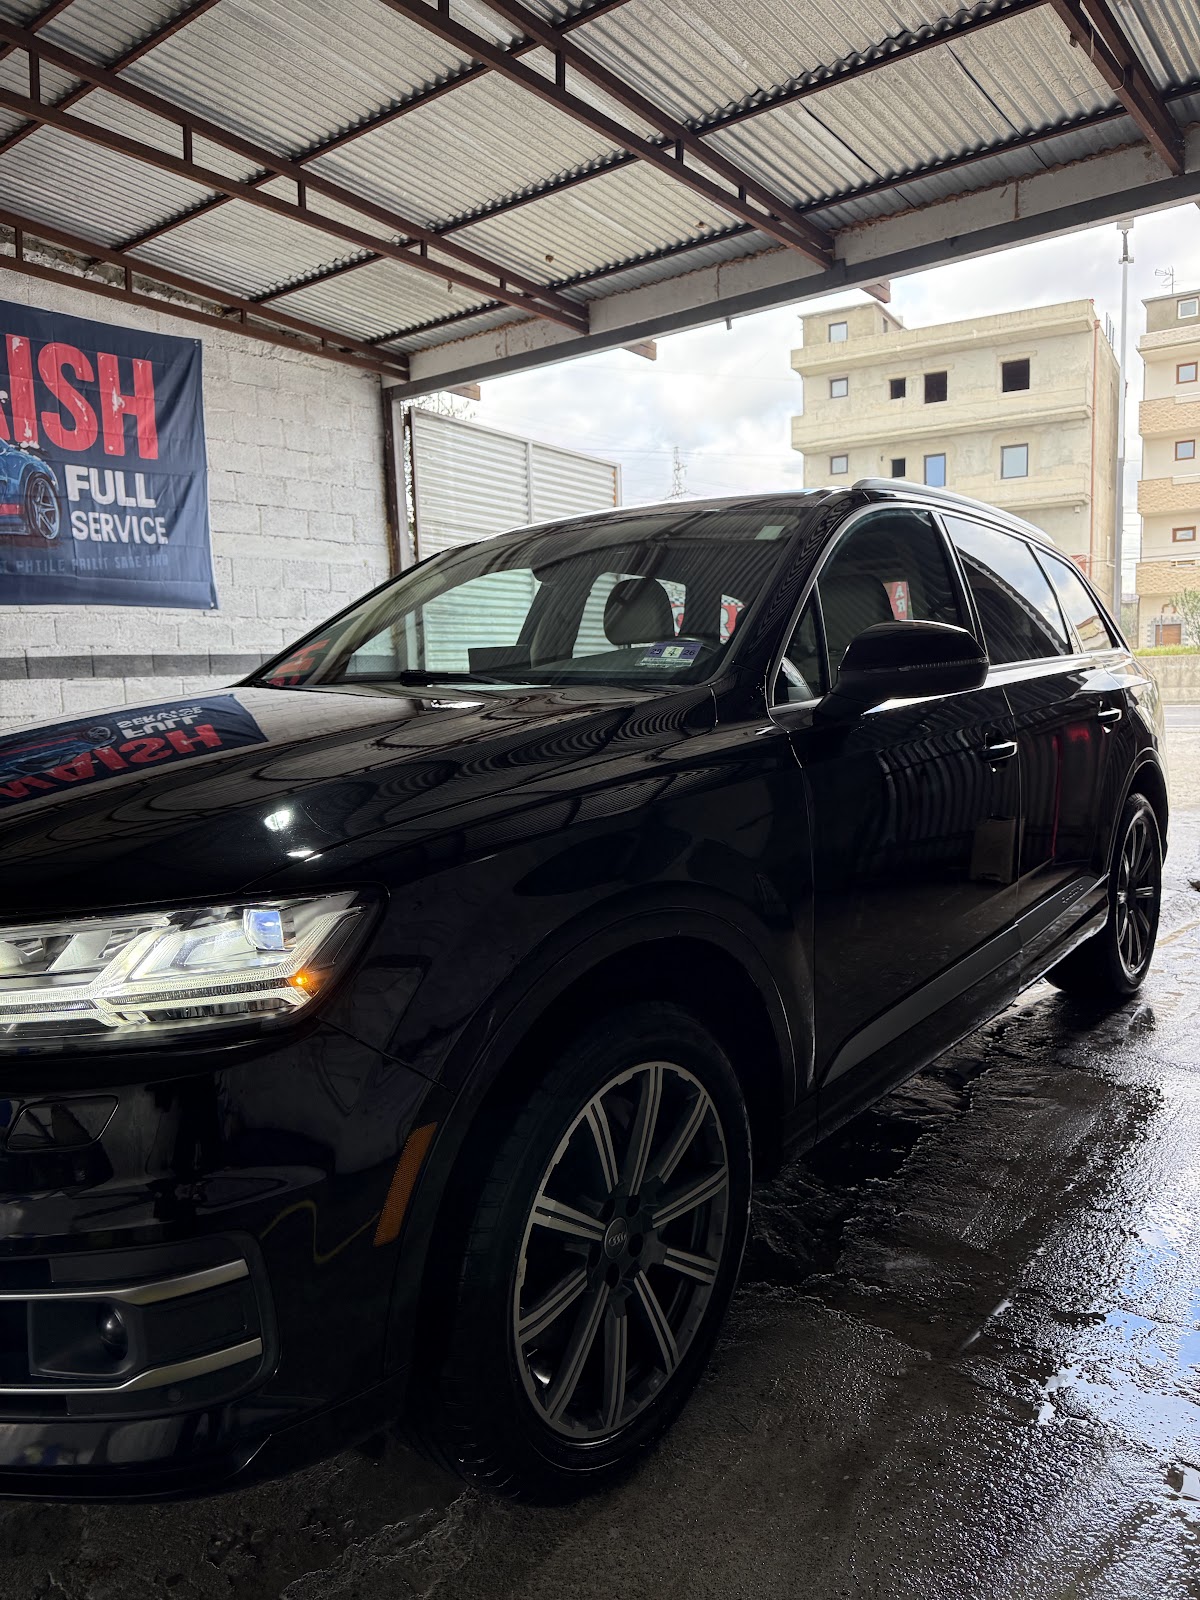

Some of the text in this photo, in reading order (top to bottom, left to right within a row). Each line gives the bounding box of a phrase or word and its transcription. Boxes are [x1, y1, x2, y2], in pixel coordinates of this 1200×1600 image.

[0, 333, 158, 460] ISH
[65, 464, 156, 508] FULL
[70, 510, 168, 544] SERVICE
